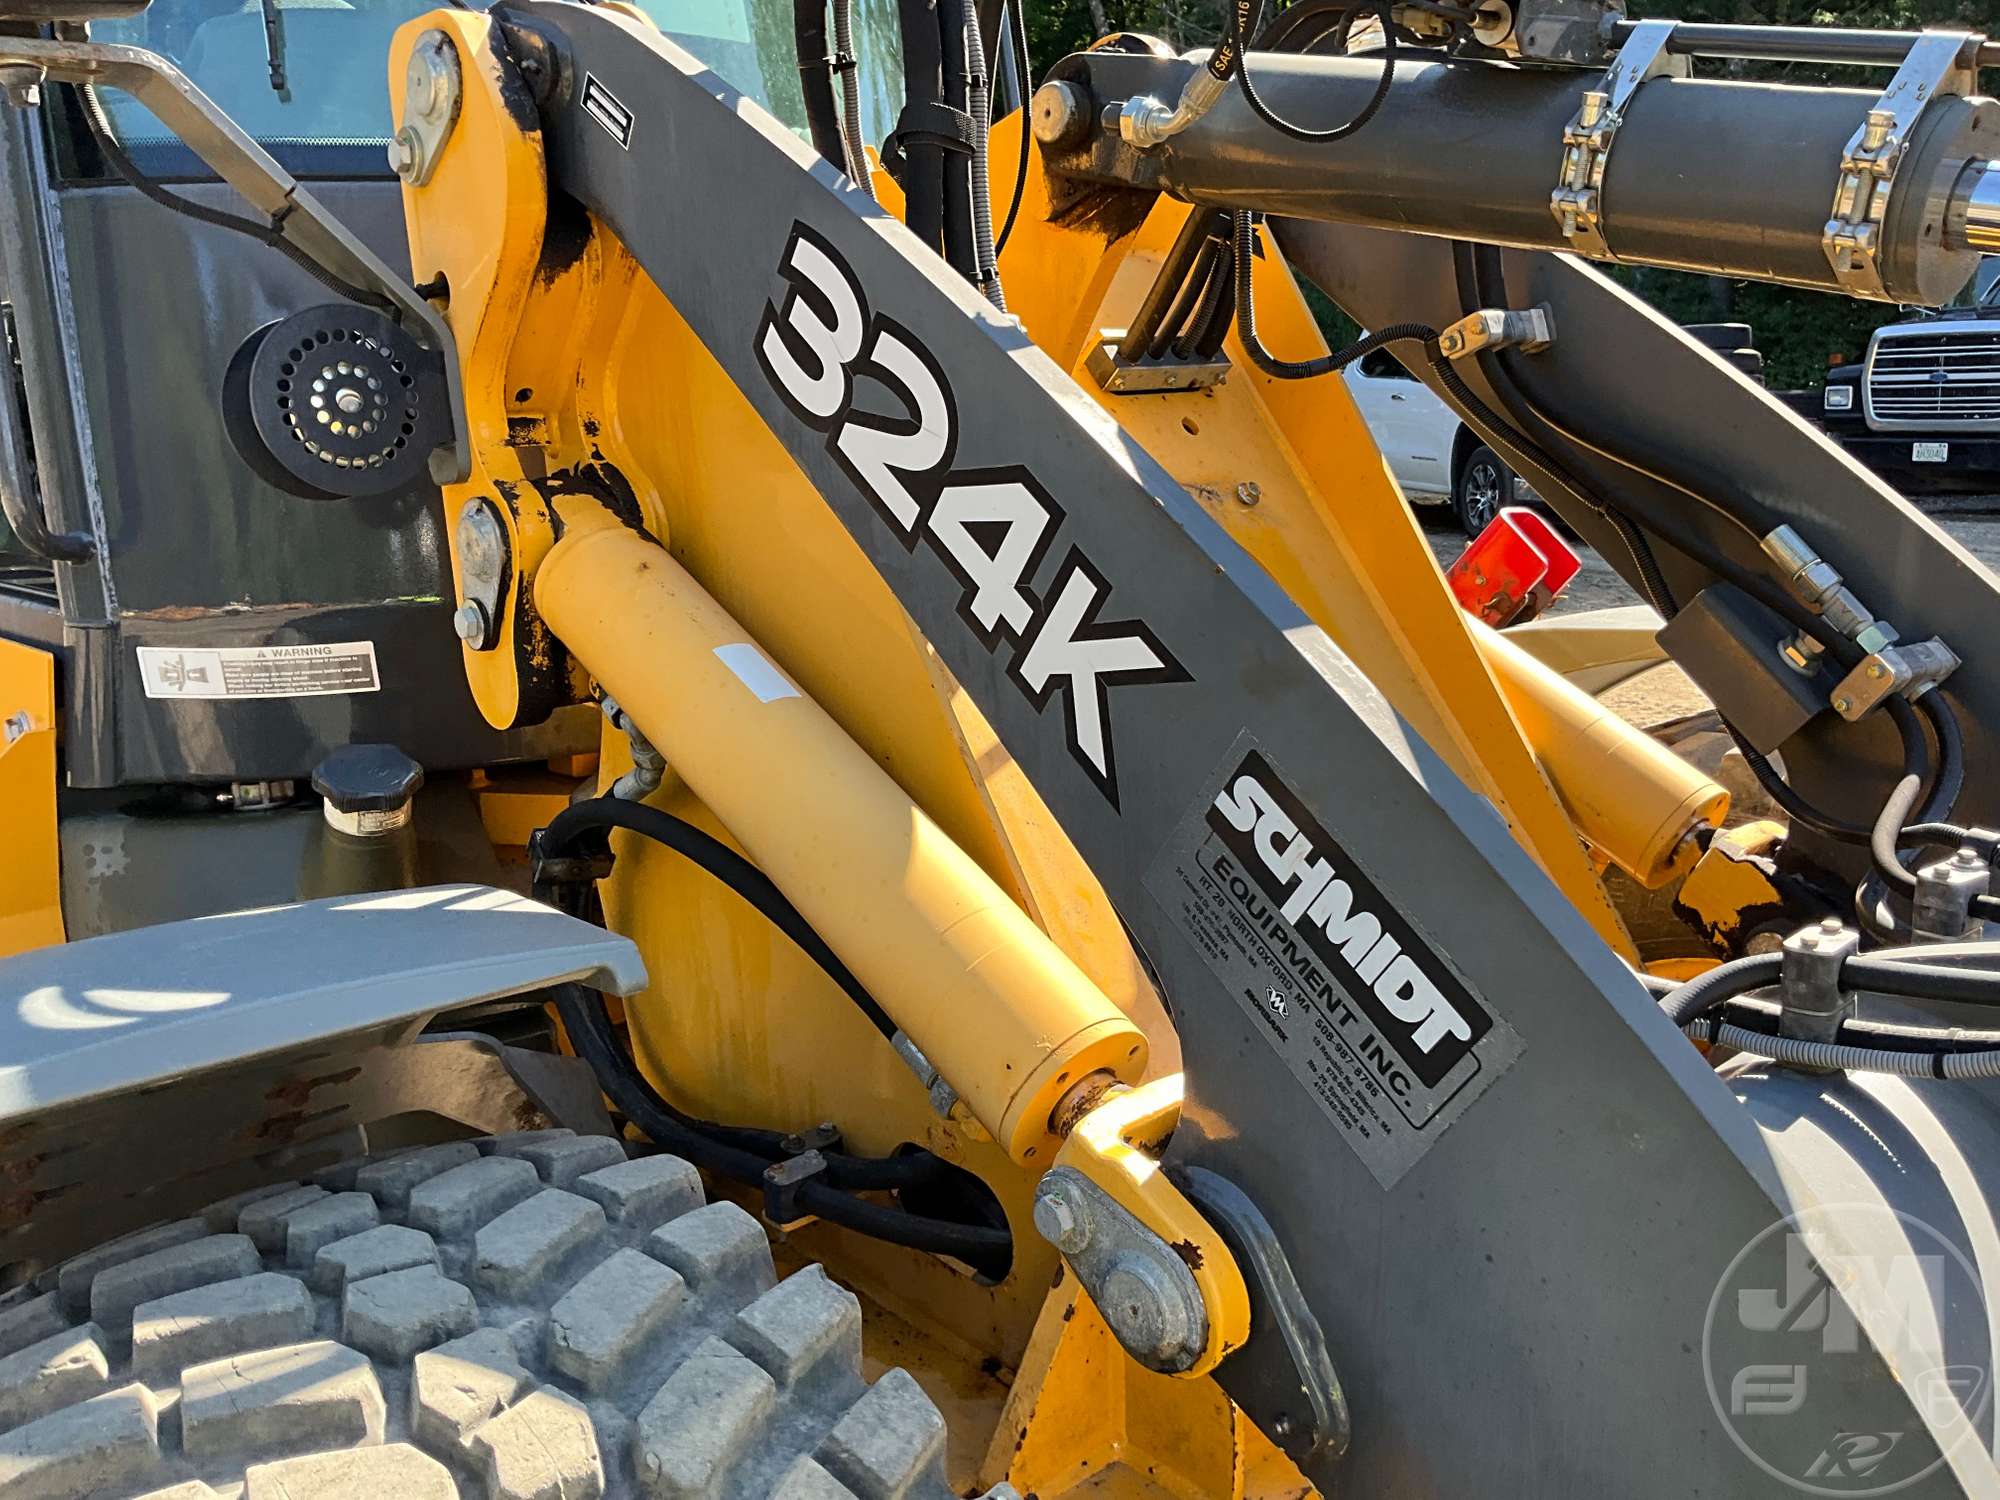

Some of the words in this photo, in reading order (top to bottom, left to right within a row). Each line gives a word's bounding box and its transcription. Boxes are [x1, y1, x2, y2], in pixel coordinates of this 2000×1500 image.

[1215, 45, 1233, 71] SAE
[760, 232, 1172, 785] 324K
[271, 646, 332, 658] WARNING
[1213, 856, 1356, 1024] EQUIPMENT
[1359, 1033, 1410, 1106] INC.
[1214, 775, 1472, 1055] SCHMIDT
[1226, 909, 1257, 946] NORTH
[1294, 992, 1310, 1013] MA
